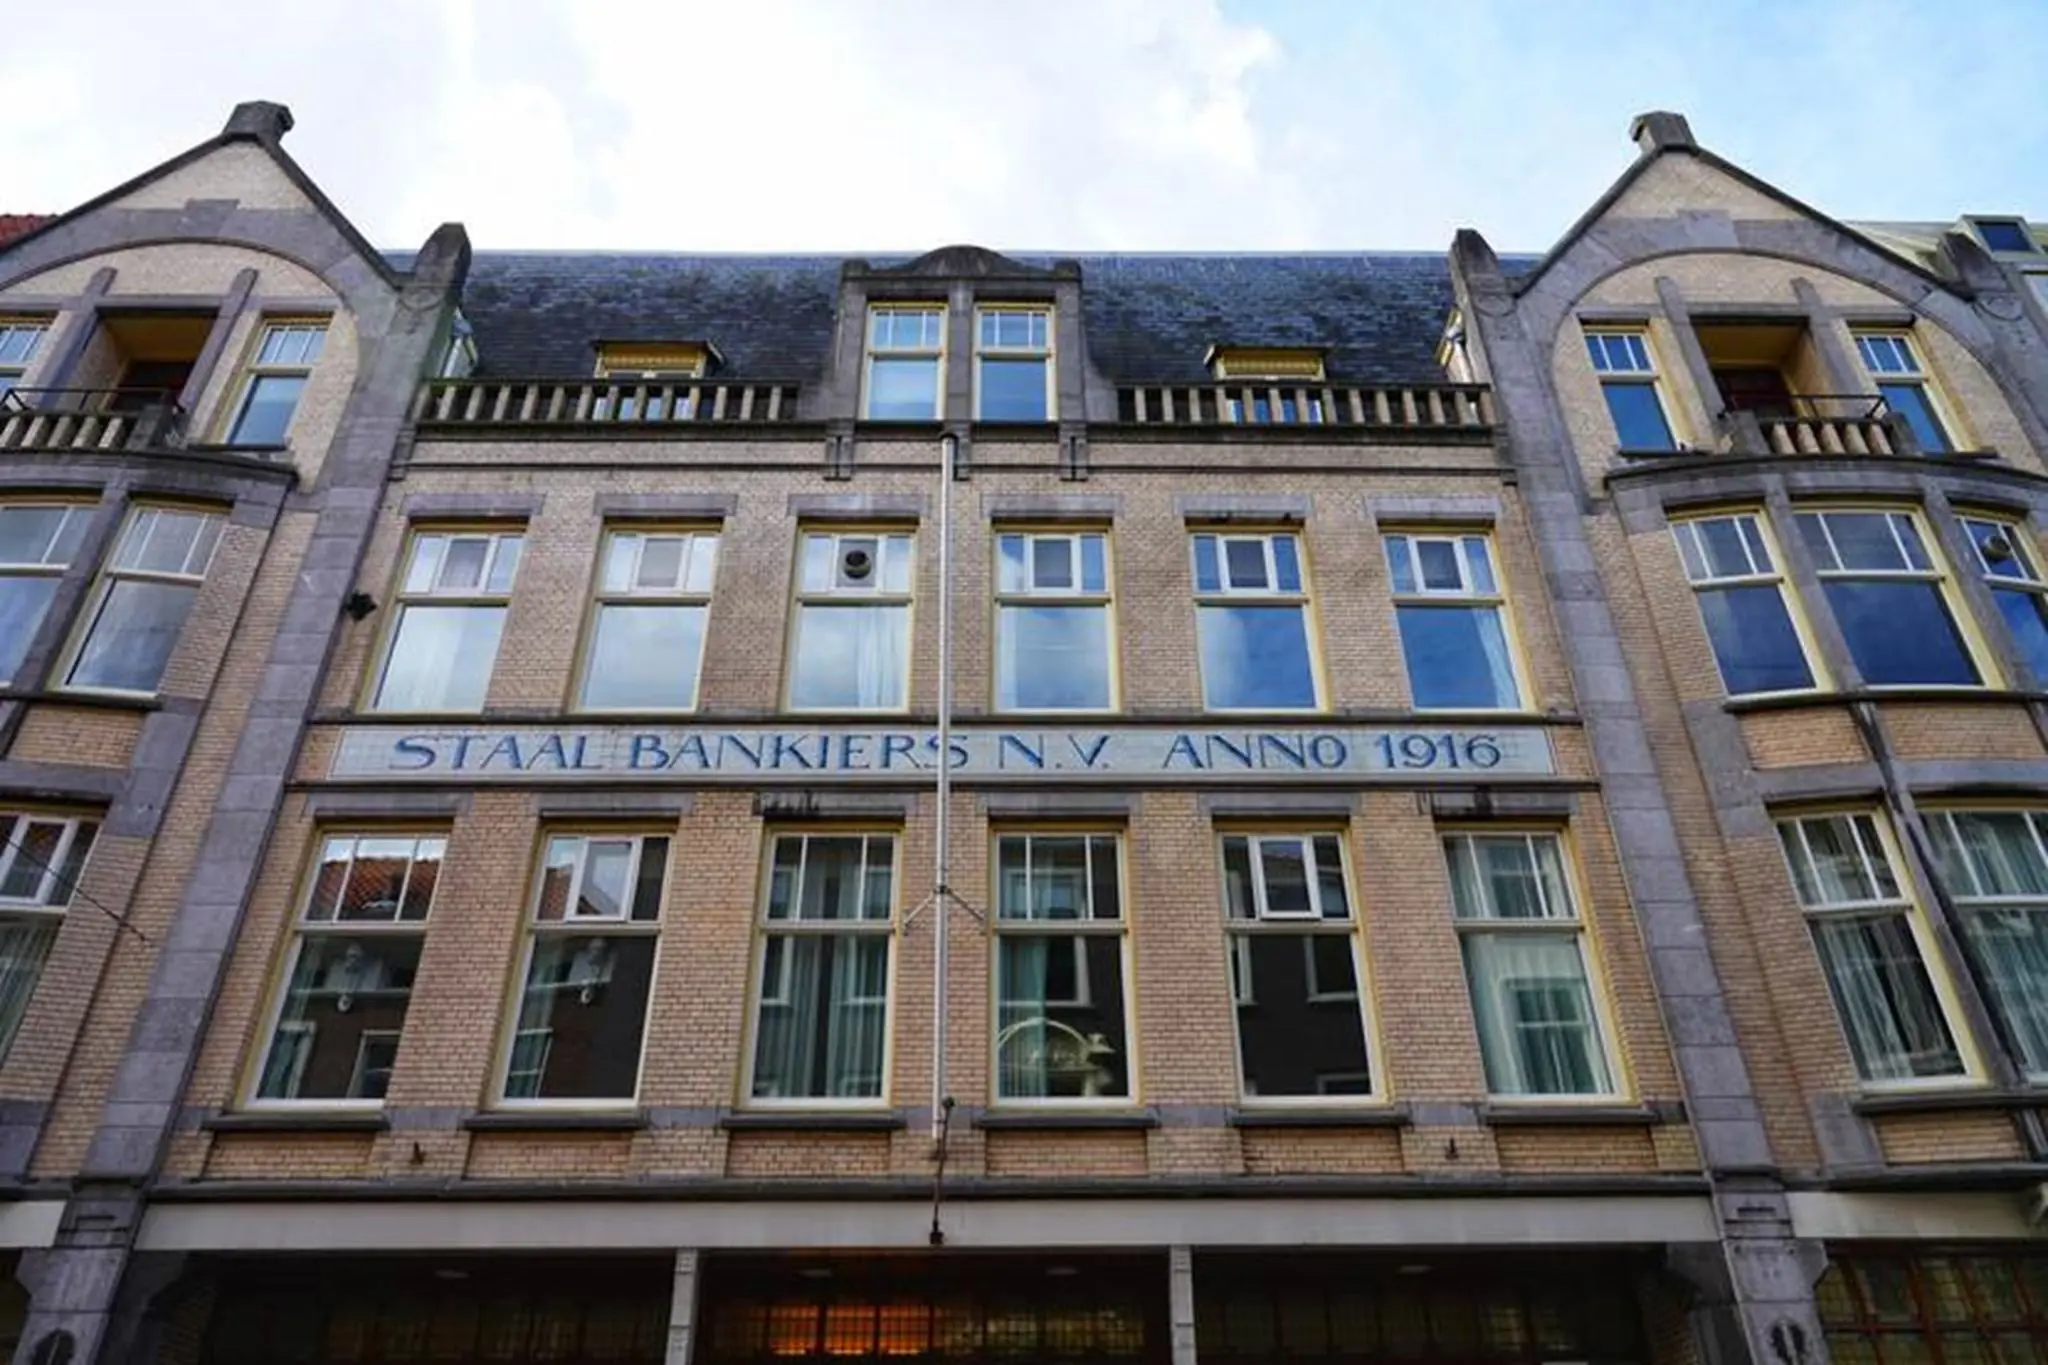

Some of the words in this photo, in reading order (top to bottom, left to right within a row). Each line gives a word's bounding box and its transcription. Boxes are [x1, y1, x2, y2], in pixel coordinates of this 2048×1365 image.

[389, 733, 605, 769] STAAL
[628, 733, 969, 769] BANKIERS
[998, 733, 1109, 769] N.V.
[1162, 733, 1347, 768] ANNO
[1375, 733, 1501, 768] 1916
